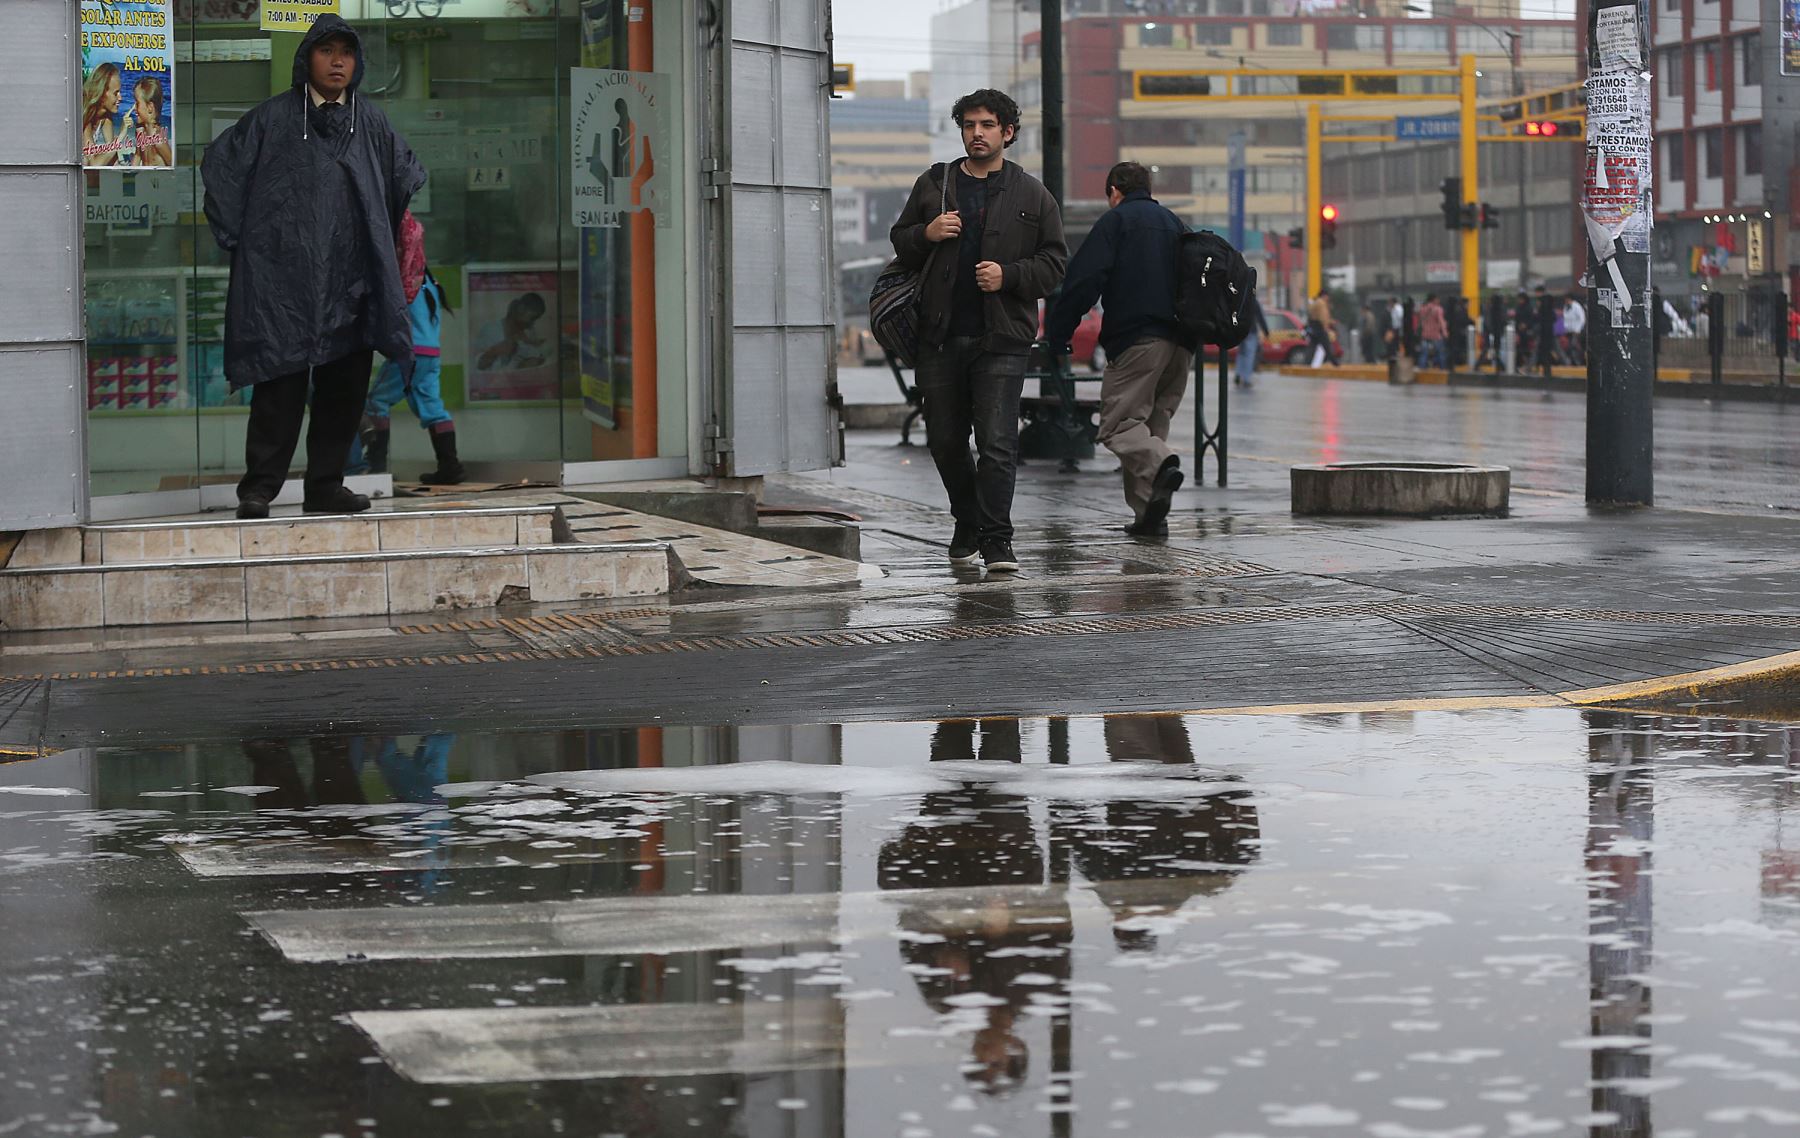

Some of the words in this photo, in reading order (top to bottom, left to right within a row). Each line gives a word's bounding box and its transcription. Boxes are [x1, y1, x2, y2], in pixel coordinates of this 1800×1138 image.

[81, 8, 122, 25] SOLAR
[124, 10, 166, 28] ANTES
[267, 11, 283, 22] 7:00
[285, 11, 297, 23] AM
[91, 31, 167, 50] EXPONERSE
[124, 56, 141, 72] AL
[143, 56, 166, 73] SOL
[1596, 134, 1649, 148] PRESTAMOS
[1618, 145, 1636, 153] CON
[574, 185, 603, 197] MADRE
